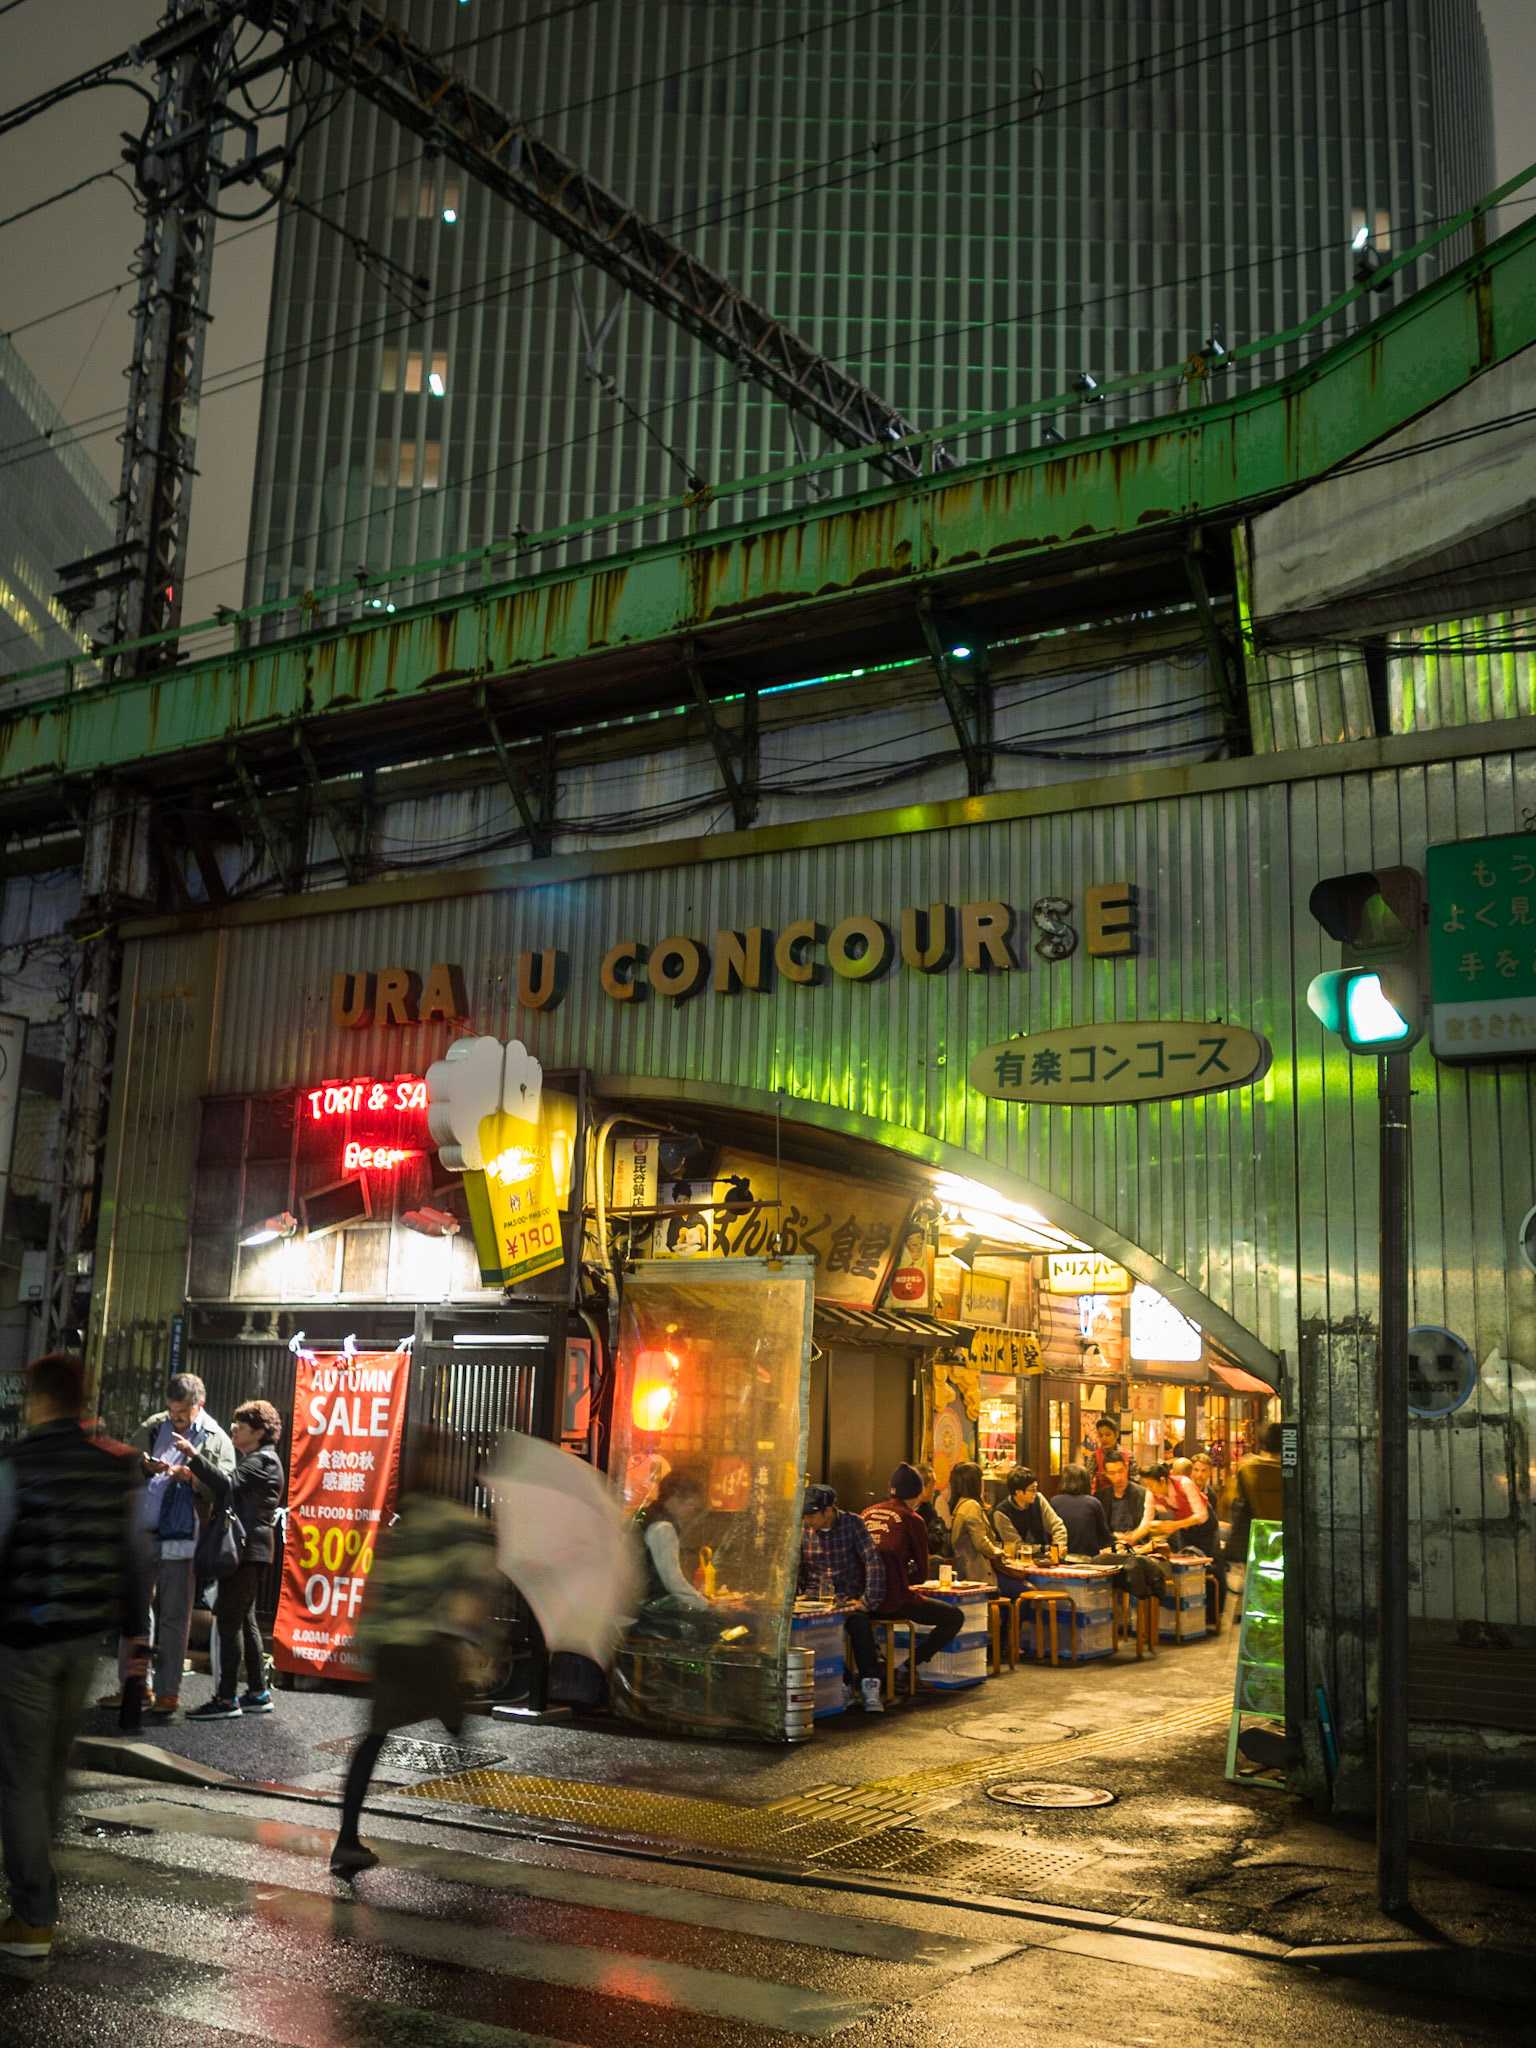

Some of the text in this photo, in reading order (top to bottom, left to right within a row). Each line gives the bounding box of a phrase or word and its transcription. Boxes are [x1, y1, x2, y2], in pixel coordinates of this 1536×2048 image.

[1442, 896, 1534, 933] よく見
[332, 962, 466, 1028] URA
[600, 882, 1140, 1002] CONCOURSE
[1458, 949, 1536, 982] 手を
[994, 1036, 1231, 1088] 有楽コンコース
[308, 1084, 363, 1119] TORI
[368, 1082, 388, 1110] &
[344, 1141, 405, 1169] Beer
[633, 1155, 648, 1207] 日比谷質店
[1054, 1260, 1122, 1276] トリスバー
[310, 1369, 393, 1393] AUTUMN
[307, 1396, 390, 1437] SALE
[316, 1449, 375, 1472] 食欲の秋
[1282, 1429, 1297, 1466] RULER
[322, 1471, 366, 1493] 感謝祭
[299, 1504, 316, 1519] ALL
[317, 1505, 346, 1520] FOOD
[346, 1507, 354, 1521] &
[299, 1525, 374, 1575] 30%
[304, 1573, 365, 1618] OFF
[291, 1645, 364, 1665] WEEKDAY ONL
